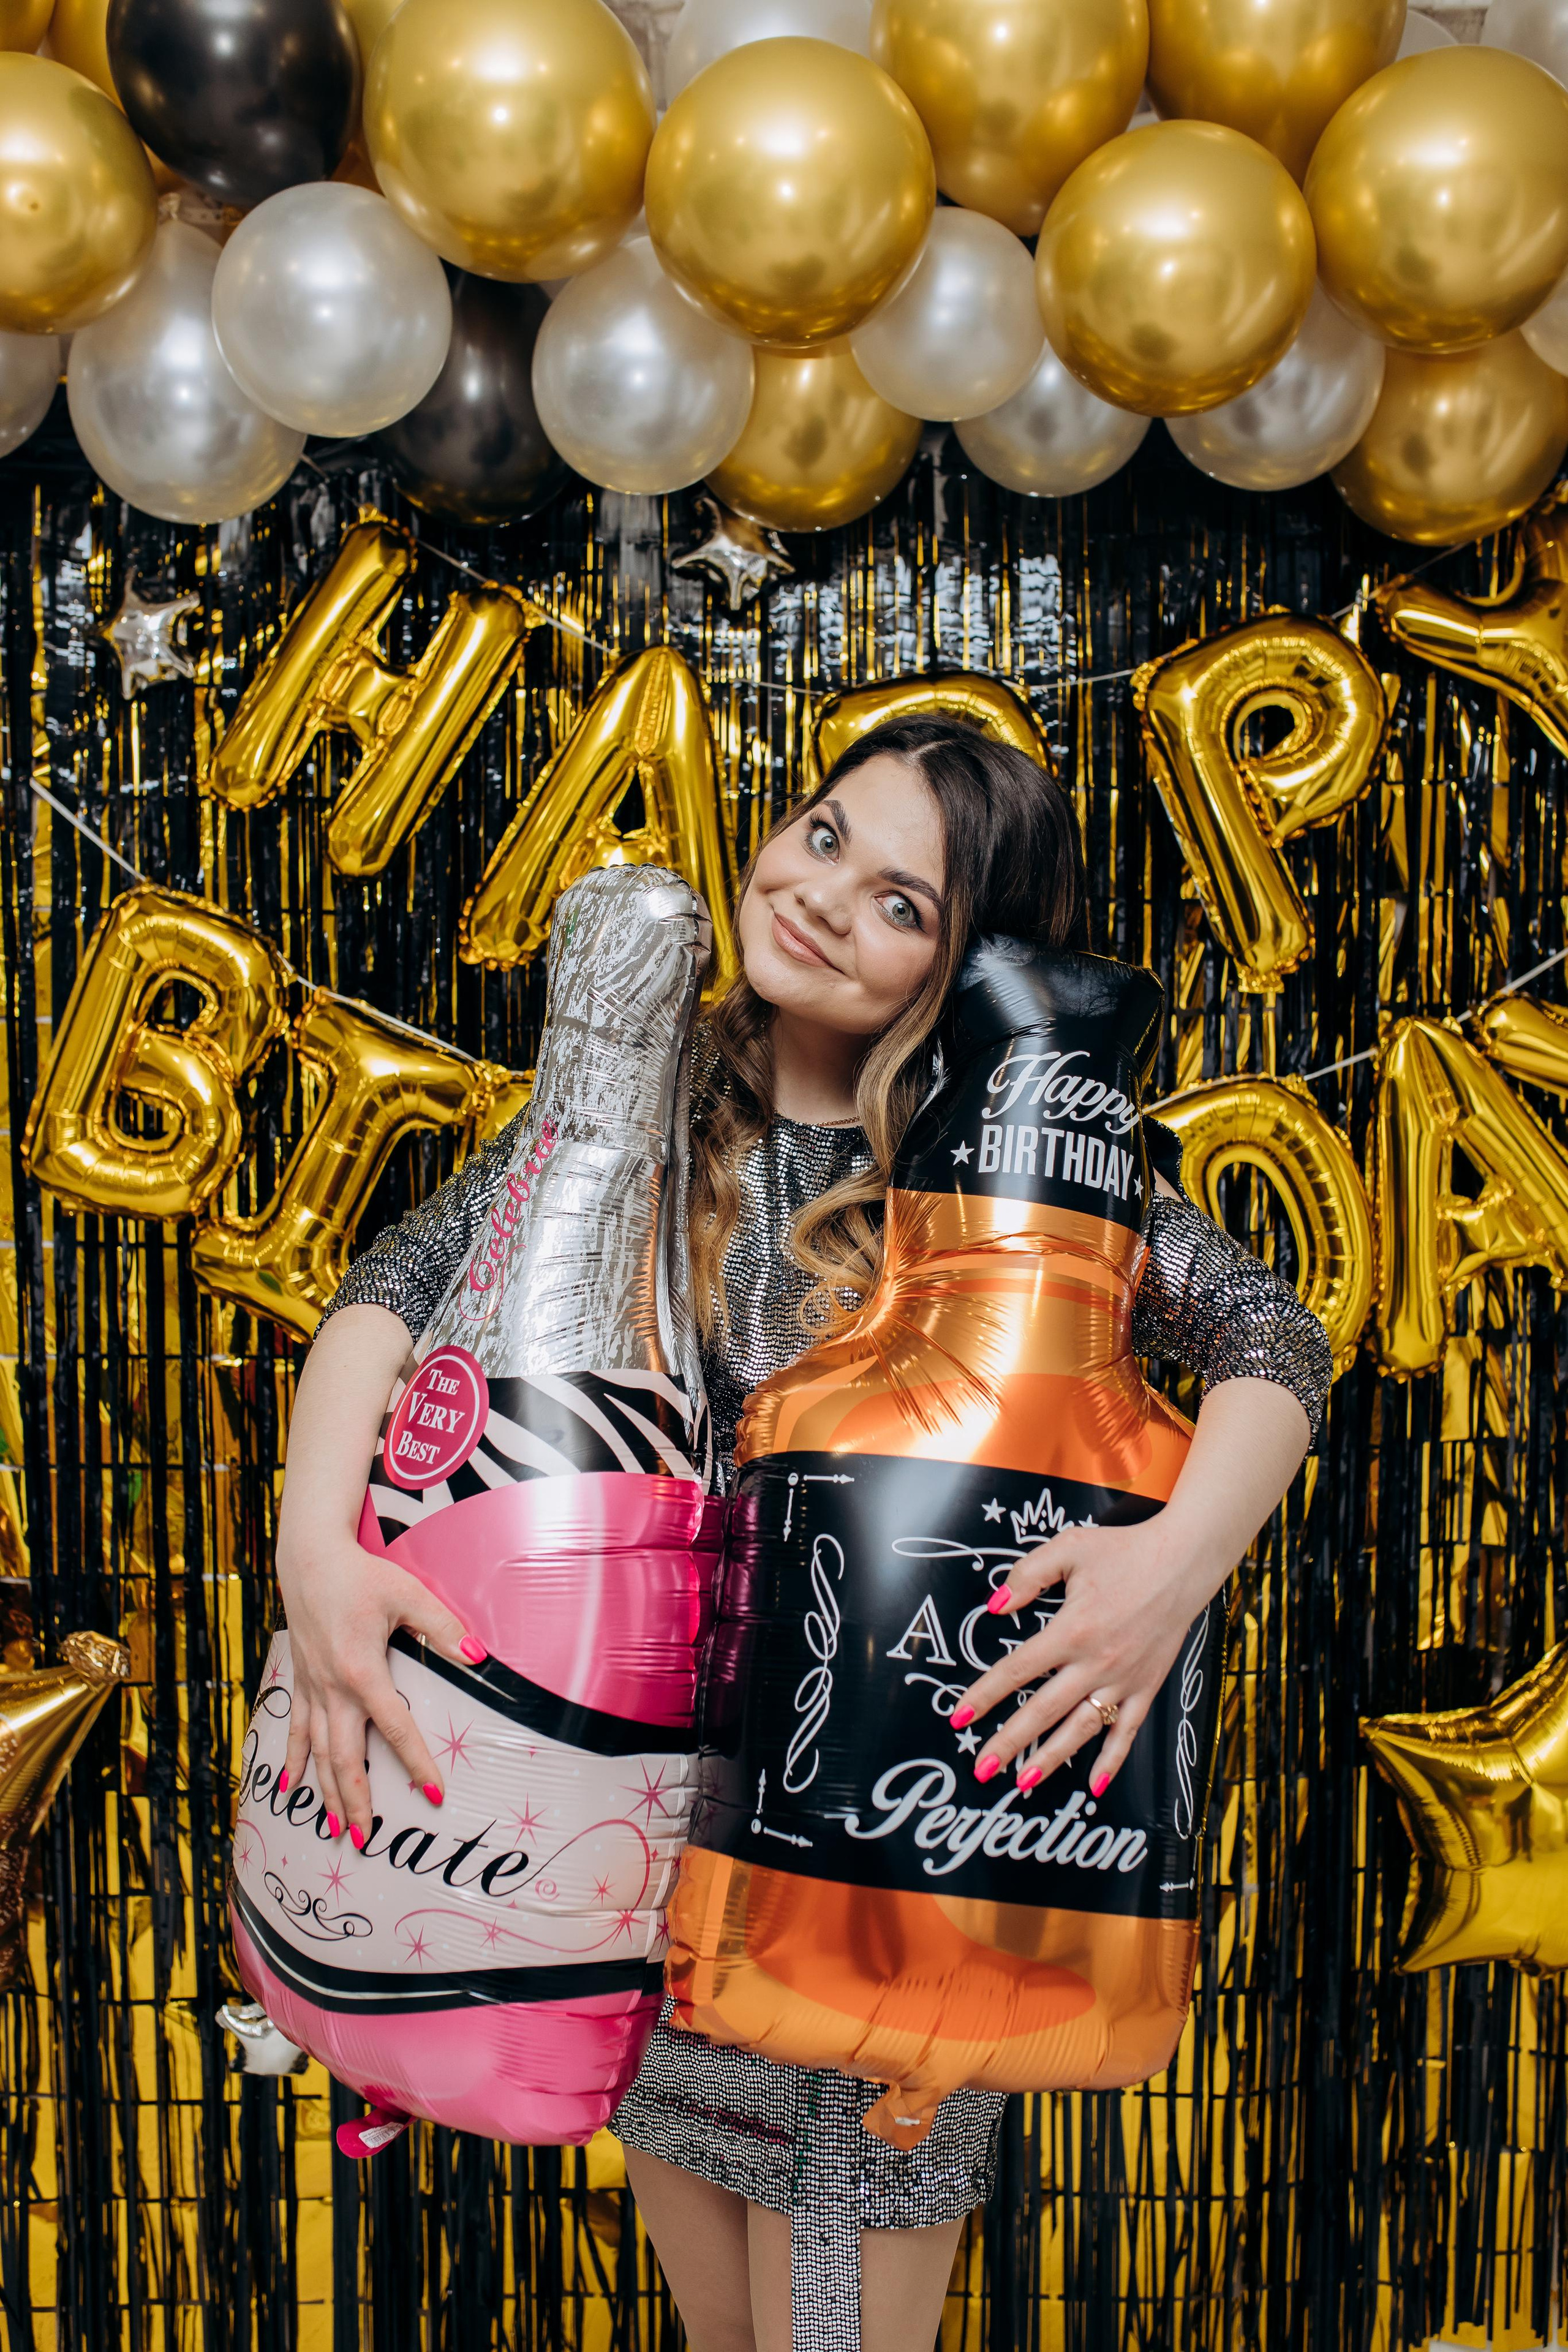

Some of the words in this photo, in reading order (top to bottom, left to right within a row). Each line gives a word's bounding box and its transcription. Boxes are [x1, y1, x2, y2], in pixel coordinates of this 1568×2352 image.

[981, 1050, 1140, 1135] Happy
[978, 1124, 1134, 1201] BIRTHDAY
[459, 1114, 559, 1321] Celebrae
[408, 1391, 466, 1434] VERY
[426, 1368, 461, 1396] THE
[395, 1430, 441, 1465] BEST
[845, 1757, 1148, 1876] Perfection
